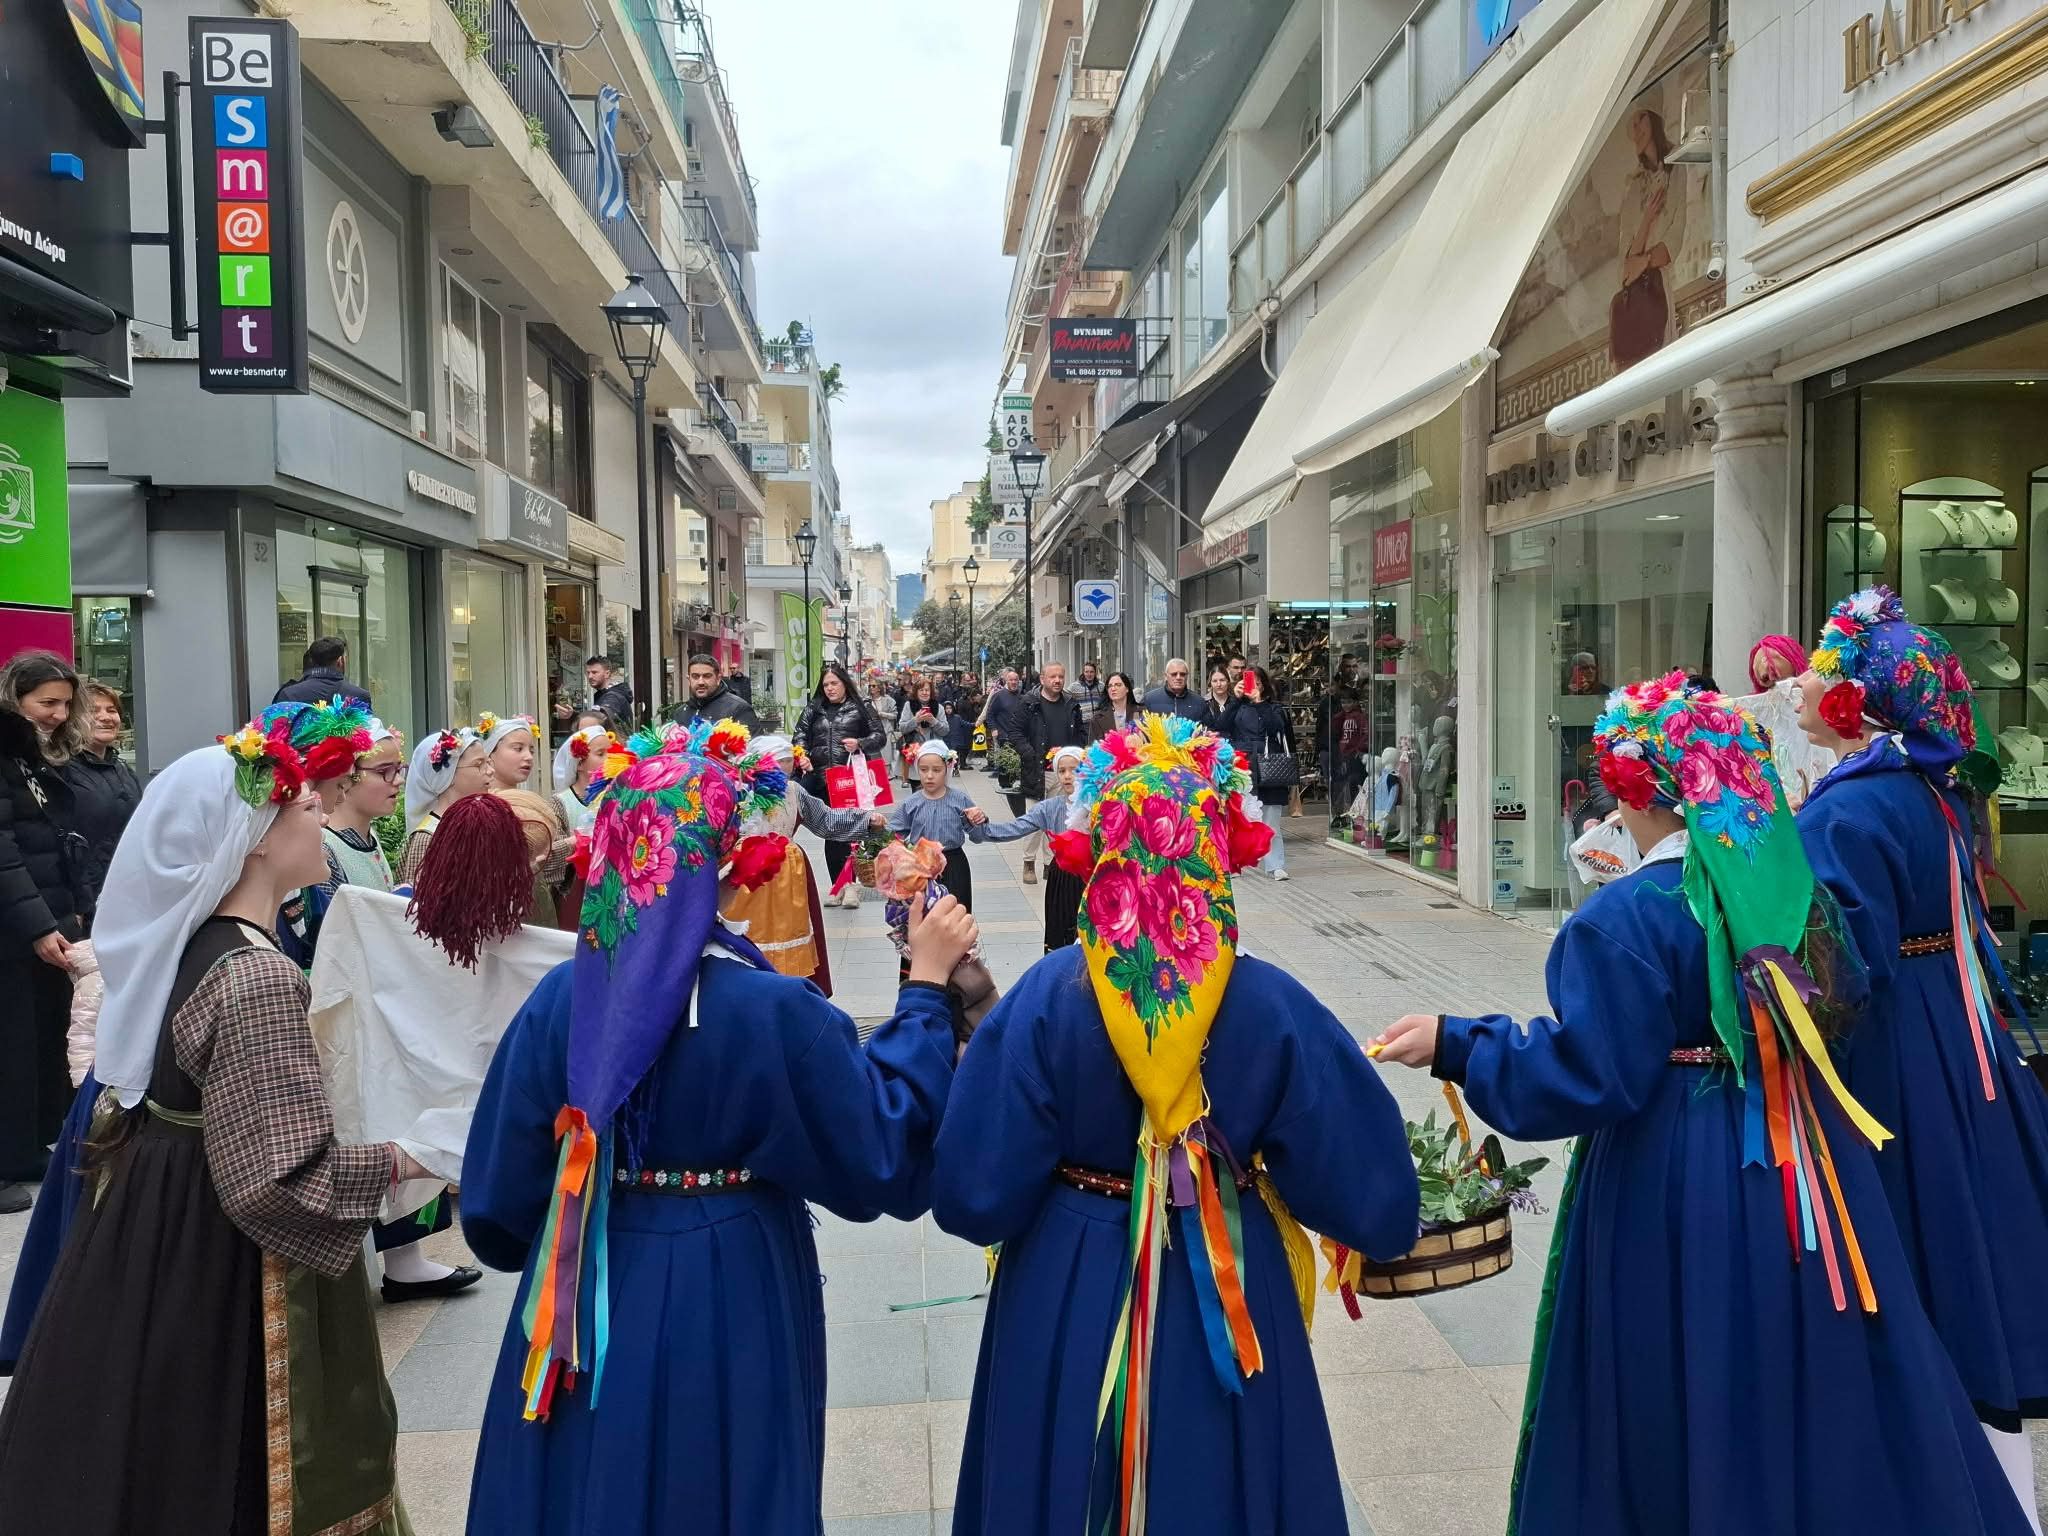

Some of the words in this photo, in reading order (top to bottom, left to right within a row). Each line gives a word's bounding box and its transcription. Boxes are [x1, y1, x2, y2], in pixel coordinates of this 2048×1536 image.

[205, 36, 270, 84] Be
[35, 231, 66, 263] Δώρα
[1073, 328, 1113, 336] DYNAMIC
[209, 367, 287, 378] www.e-besmart.gr
[254, 542, 268, 562] 32
[1376, 531, 1408, 569] JUNIOR
[1495, 803, 1524, 813] POLO
